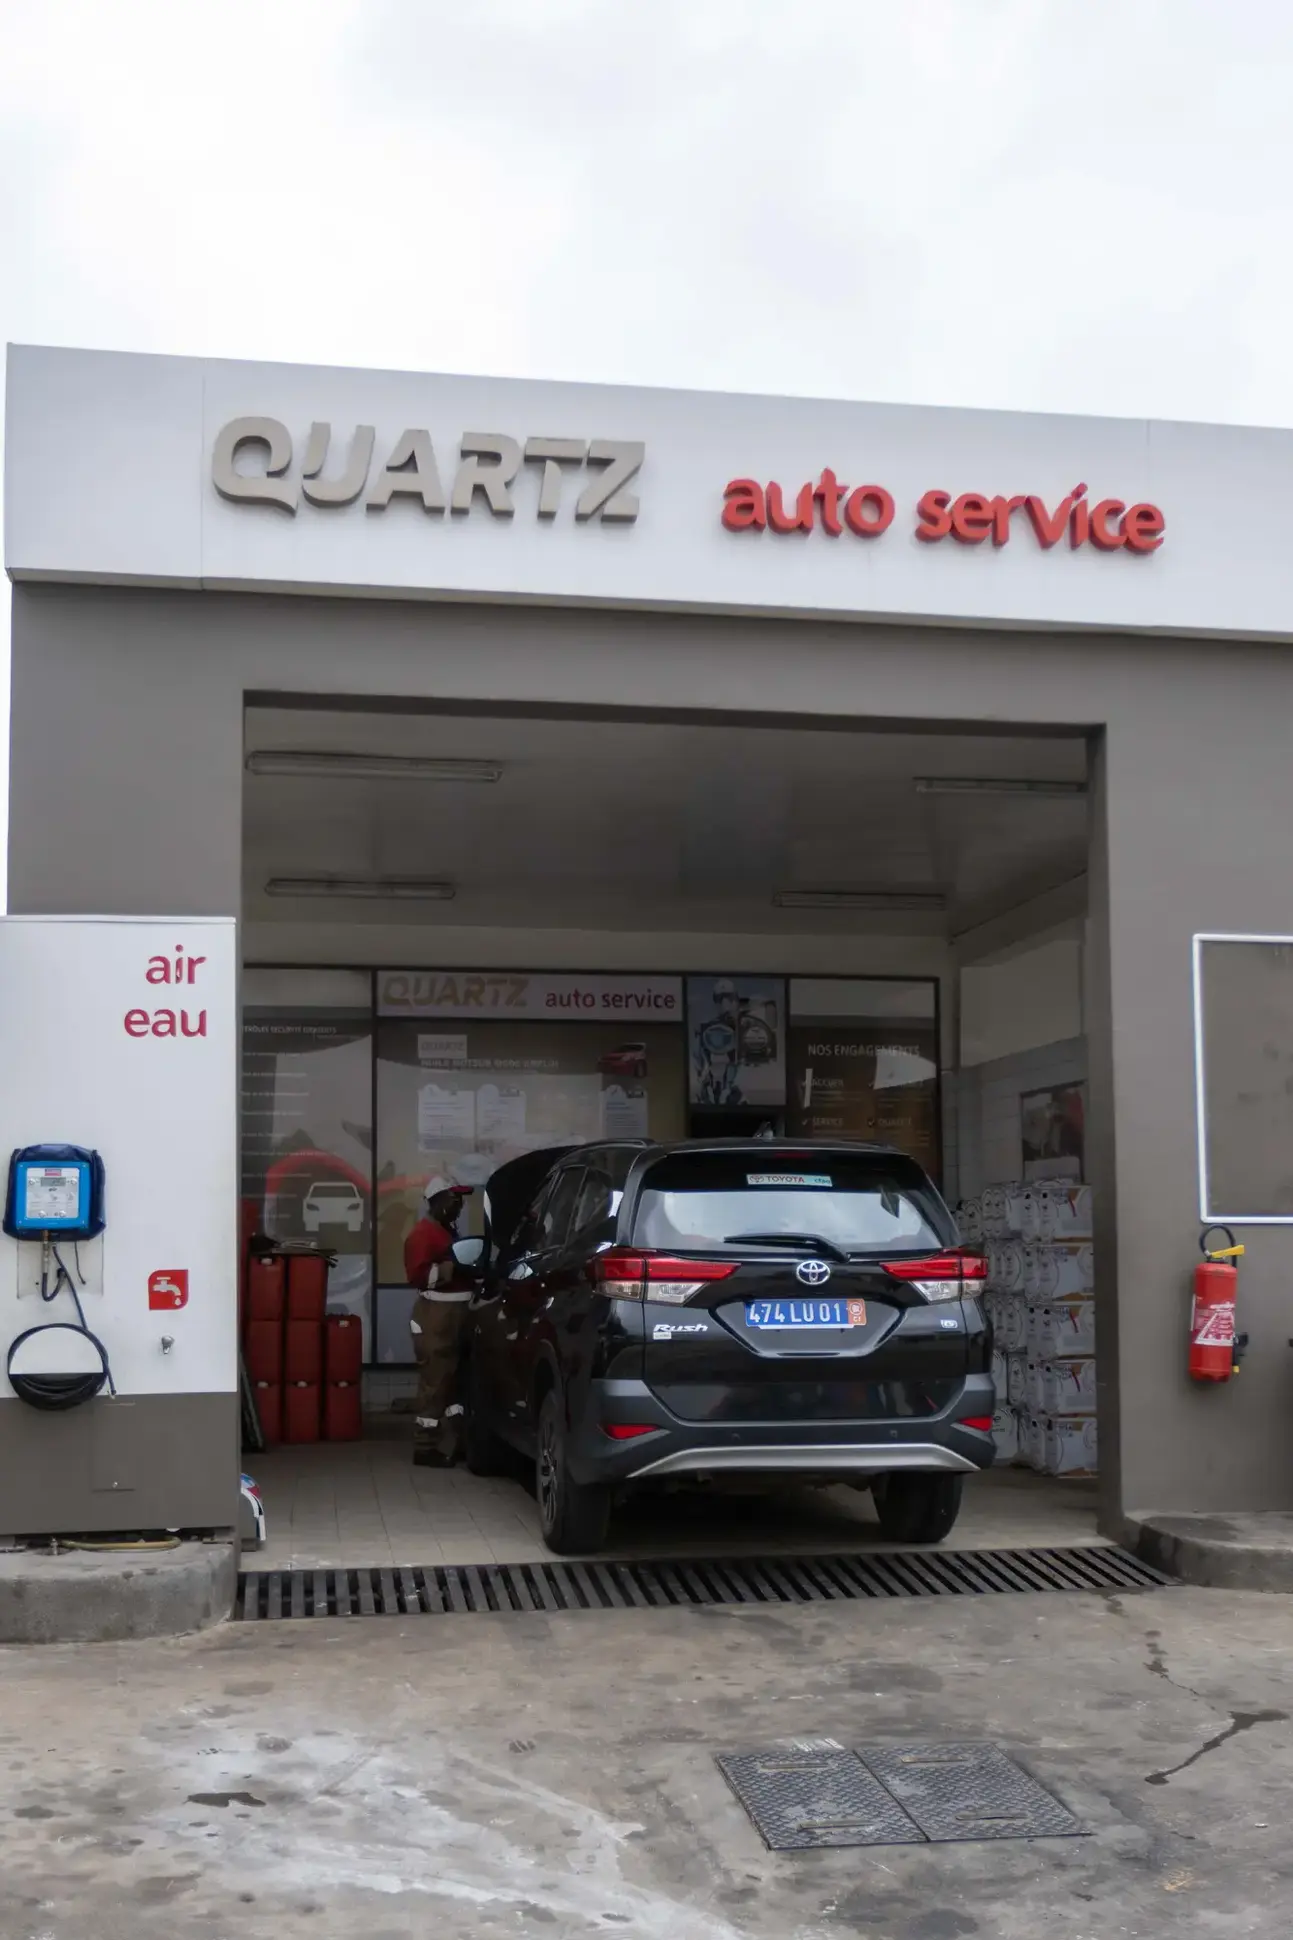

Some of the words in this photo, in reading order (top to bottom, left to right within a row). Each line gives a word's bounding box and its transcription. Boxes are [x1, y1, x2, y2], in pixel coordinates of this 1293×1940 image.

[212, 416, 646, 523] QUARTZ
[722, 467, 896, 539] auto
[915, 482, 1166, 555] service
[145, 944, 207, 985] air
[382, 976, 530, 1009] QUARTZ
[545, 988, 596, 1009] auto
[601, 988, 676, 1010] service
[124, 1008, 207, 1038] eau
[808, 1044, 832, 1056] NOS
[834, 1044, 920, 1057] ENGAGEMENTS
[653, 1323, 709, 1332] Rush
